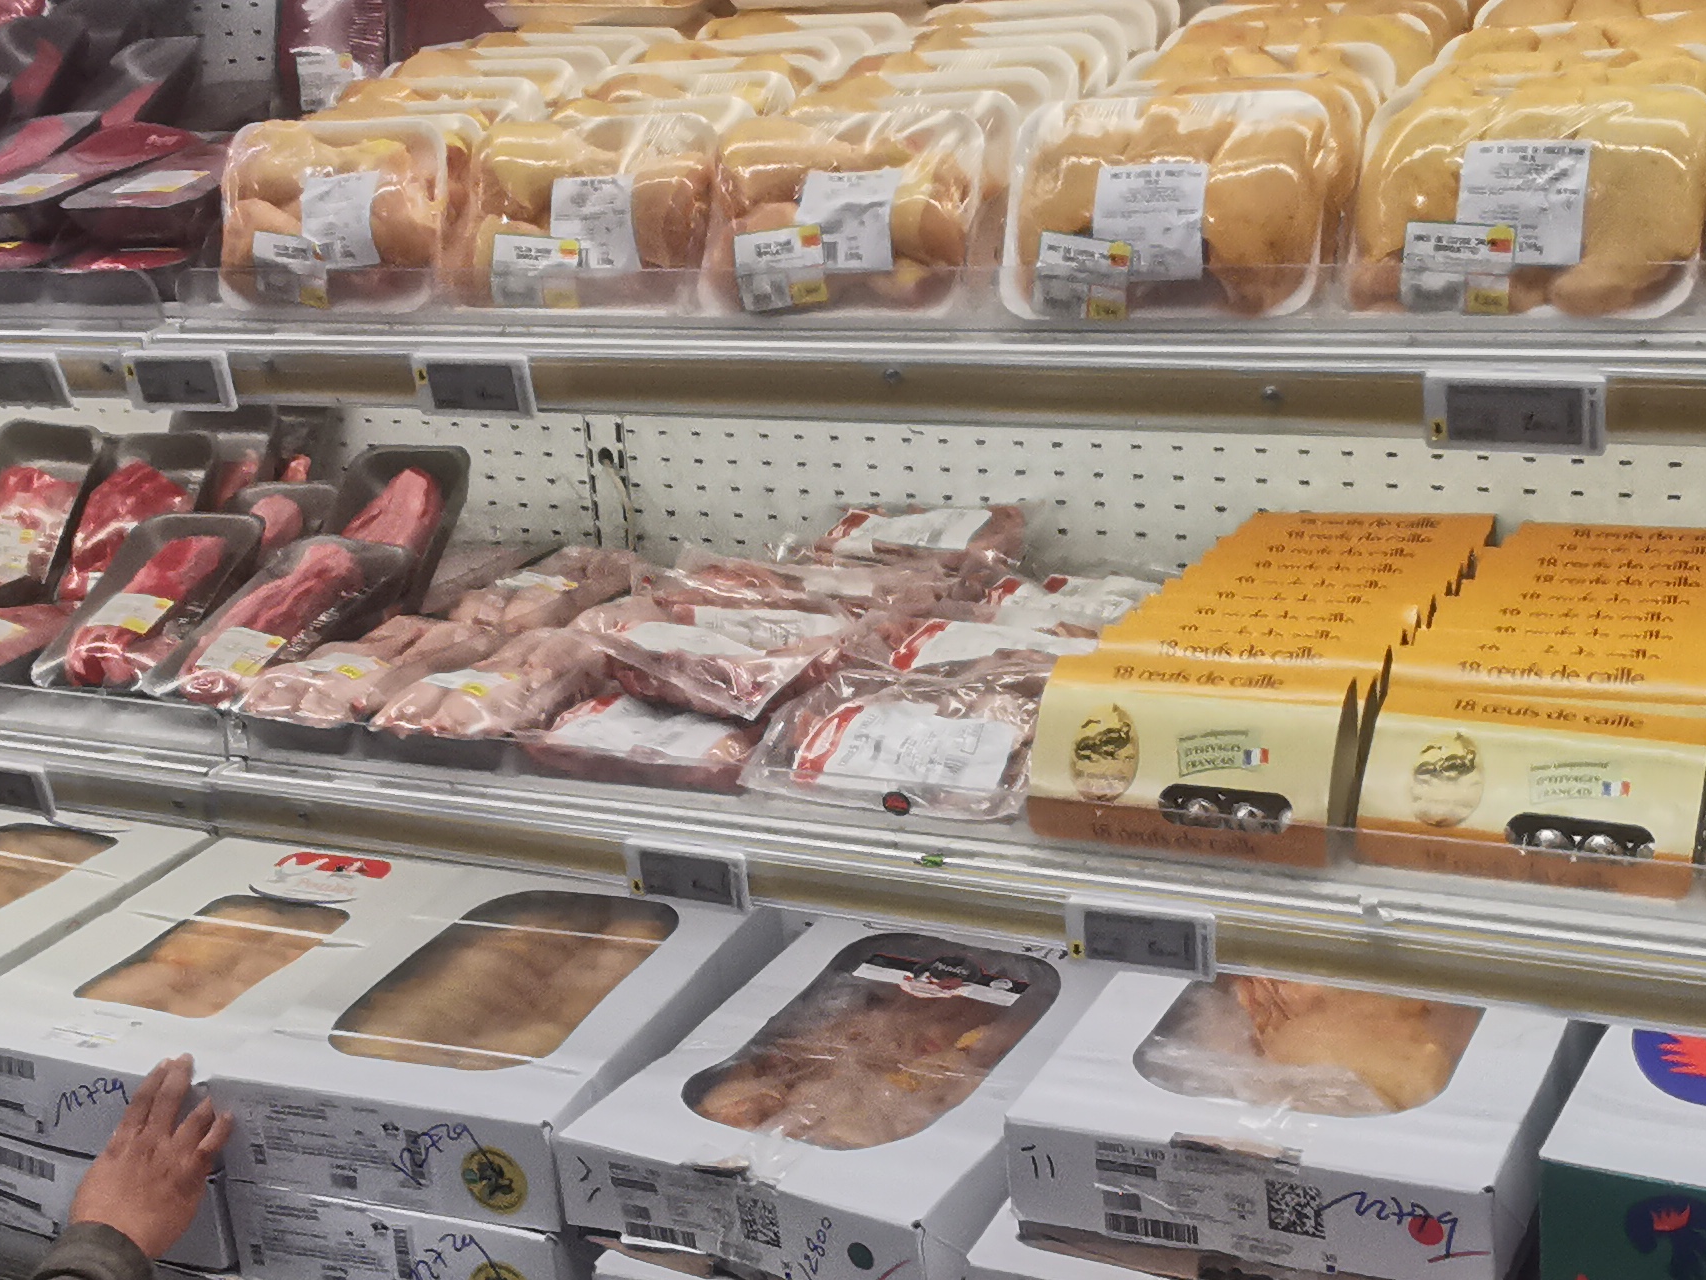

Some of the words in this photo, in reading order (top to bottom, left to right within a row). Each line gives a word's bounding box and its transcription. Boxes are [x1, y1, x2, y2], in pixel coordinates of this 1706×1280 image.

[1112, 665, 1135, 679] 18
[1197, 671, 1225, 686] de
[1229, 674, 1284, 689] caille
[1454, 699, 1476, 711] 18
